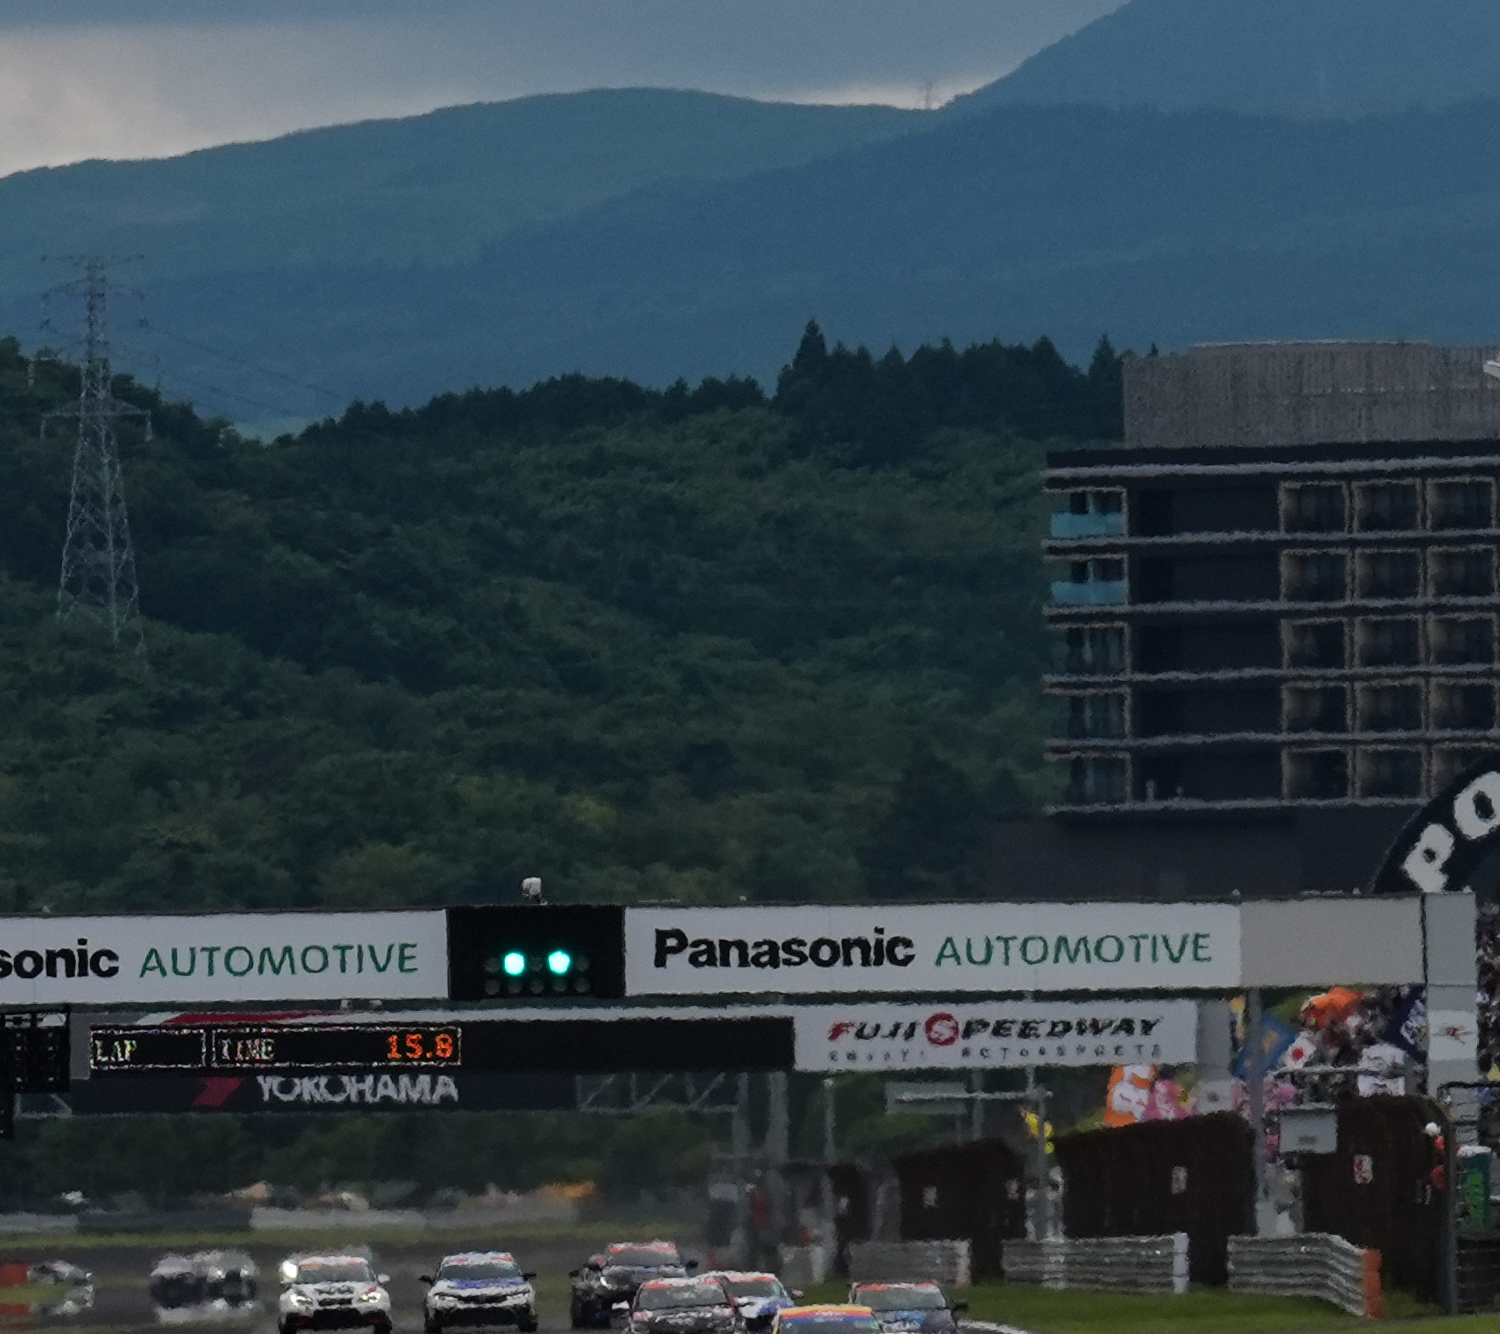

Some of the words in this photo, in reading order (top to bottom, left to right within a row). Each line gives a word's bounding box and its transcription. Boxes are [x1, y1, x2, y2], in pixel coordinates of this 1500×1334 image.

[139, 942, 419, 979] AUTOMOTIVE
[654, 926, 916, 968] Panasonic
[934, 933, 1212, 968] AUTOMOTIVE
[827, 1021, 917, 1042] FUJI
[925, 1012, 1162, 1045] SPEEDWAY
[94, 1040, 137, 1063] LAP
[219, 1037, 275, 1062] TIME
[386, 1032, 454, 1060] 15.8
[256, 1074, 459, 1104] YOKOHAMA
